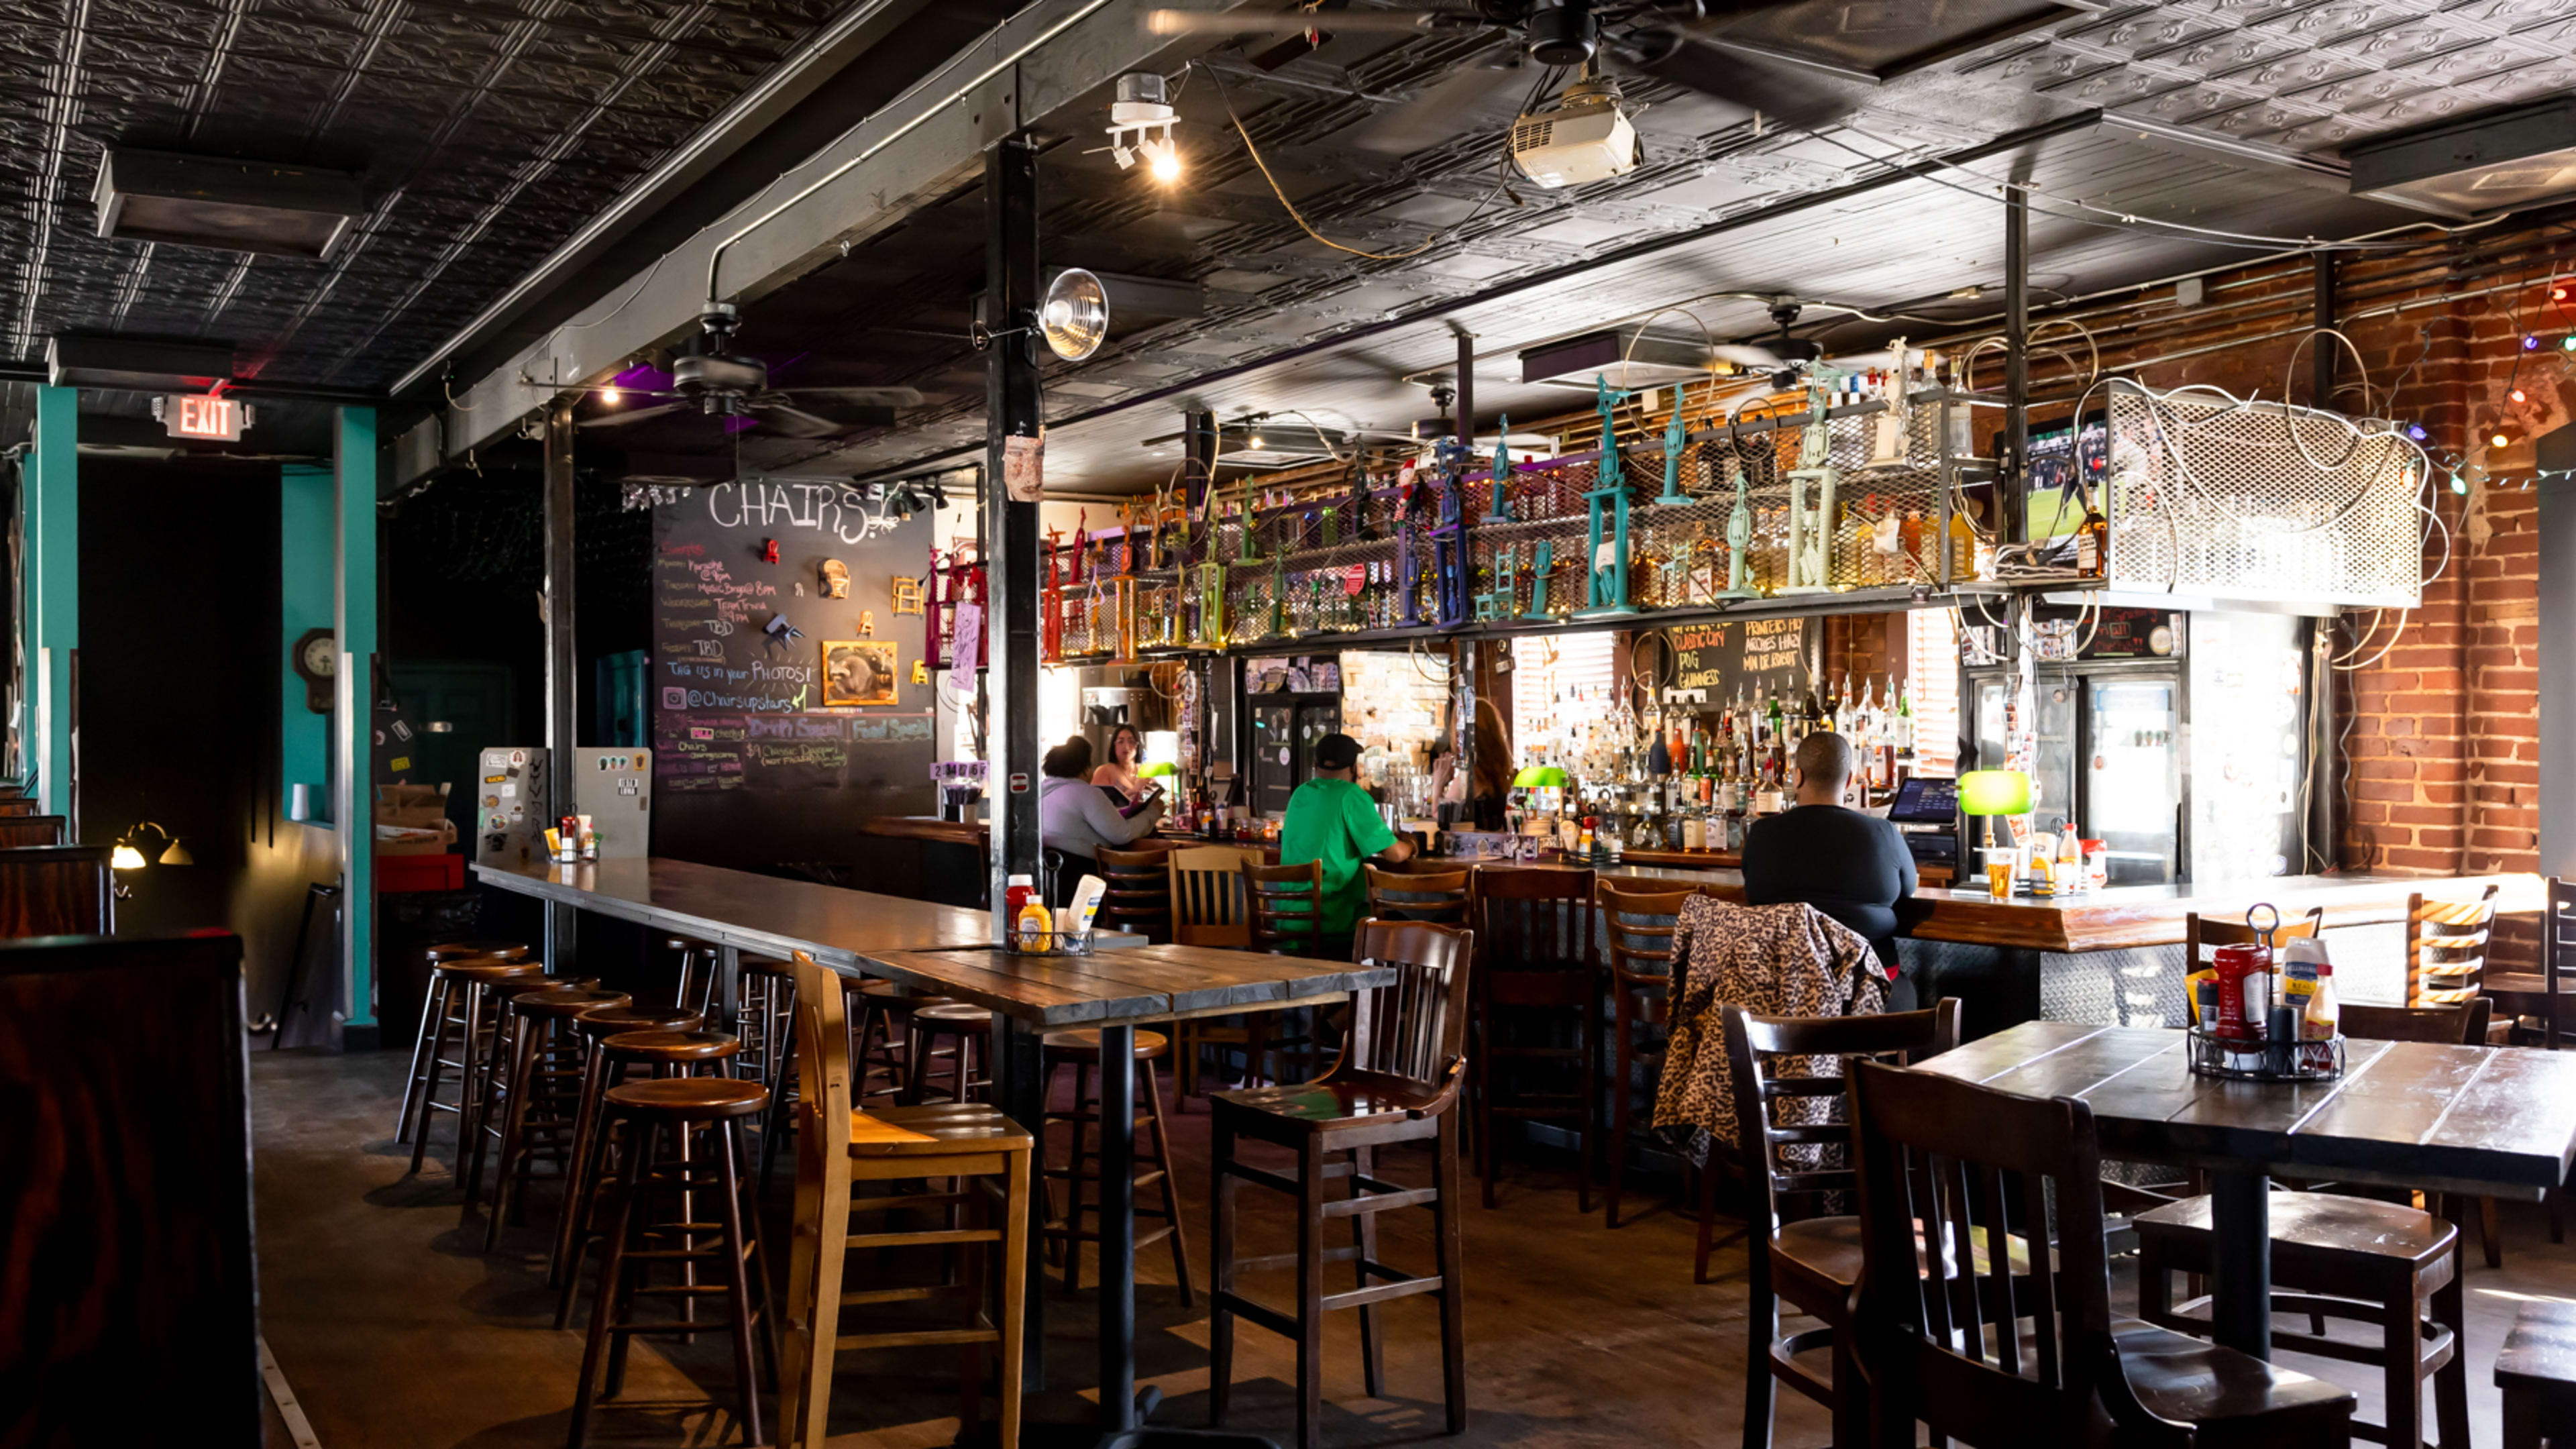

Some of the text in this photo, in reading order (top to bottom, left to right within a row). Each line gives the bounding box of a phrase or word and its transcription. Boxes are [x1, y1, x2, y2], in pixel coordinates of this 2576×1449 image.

[180, 396, 231, 435] EXIT
[704, 620, 734, 636] TBD
[1707, 630, 1724, 647] CITY
[692, 639, 723, 657] TBD
[1678, 650, 1699, 670] POG
[752, 661, 810, 682] PHOTOS!
[1678, 669, 1720, 690] GUINNESS
[688, 690, 792, 714] @Chairsupstairs
[853, 716, 933, 740] Food Special
